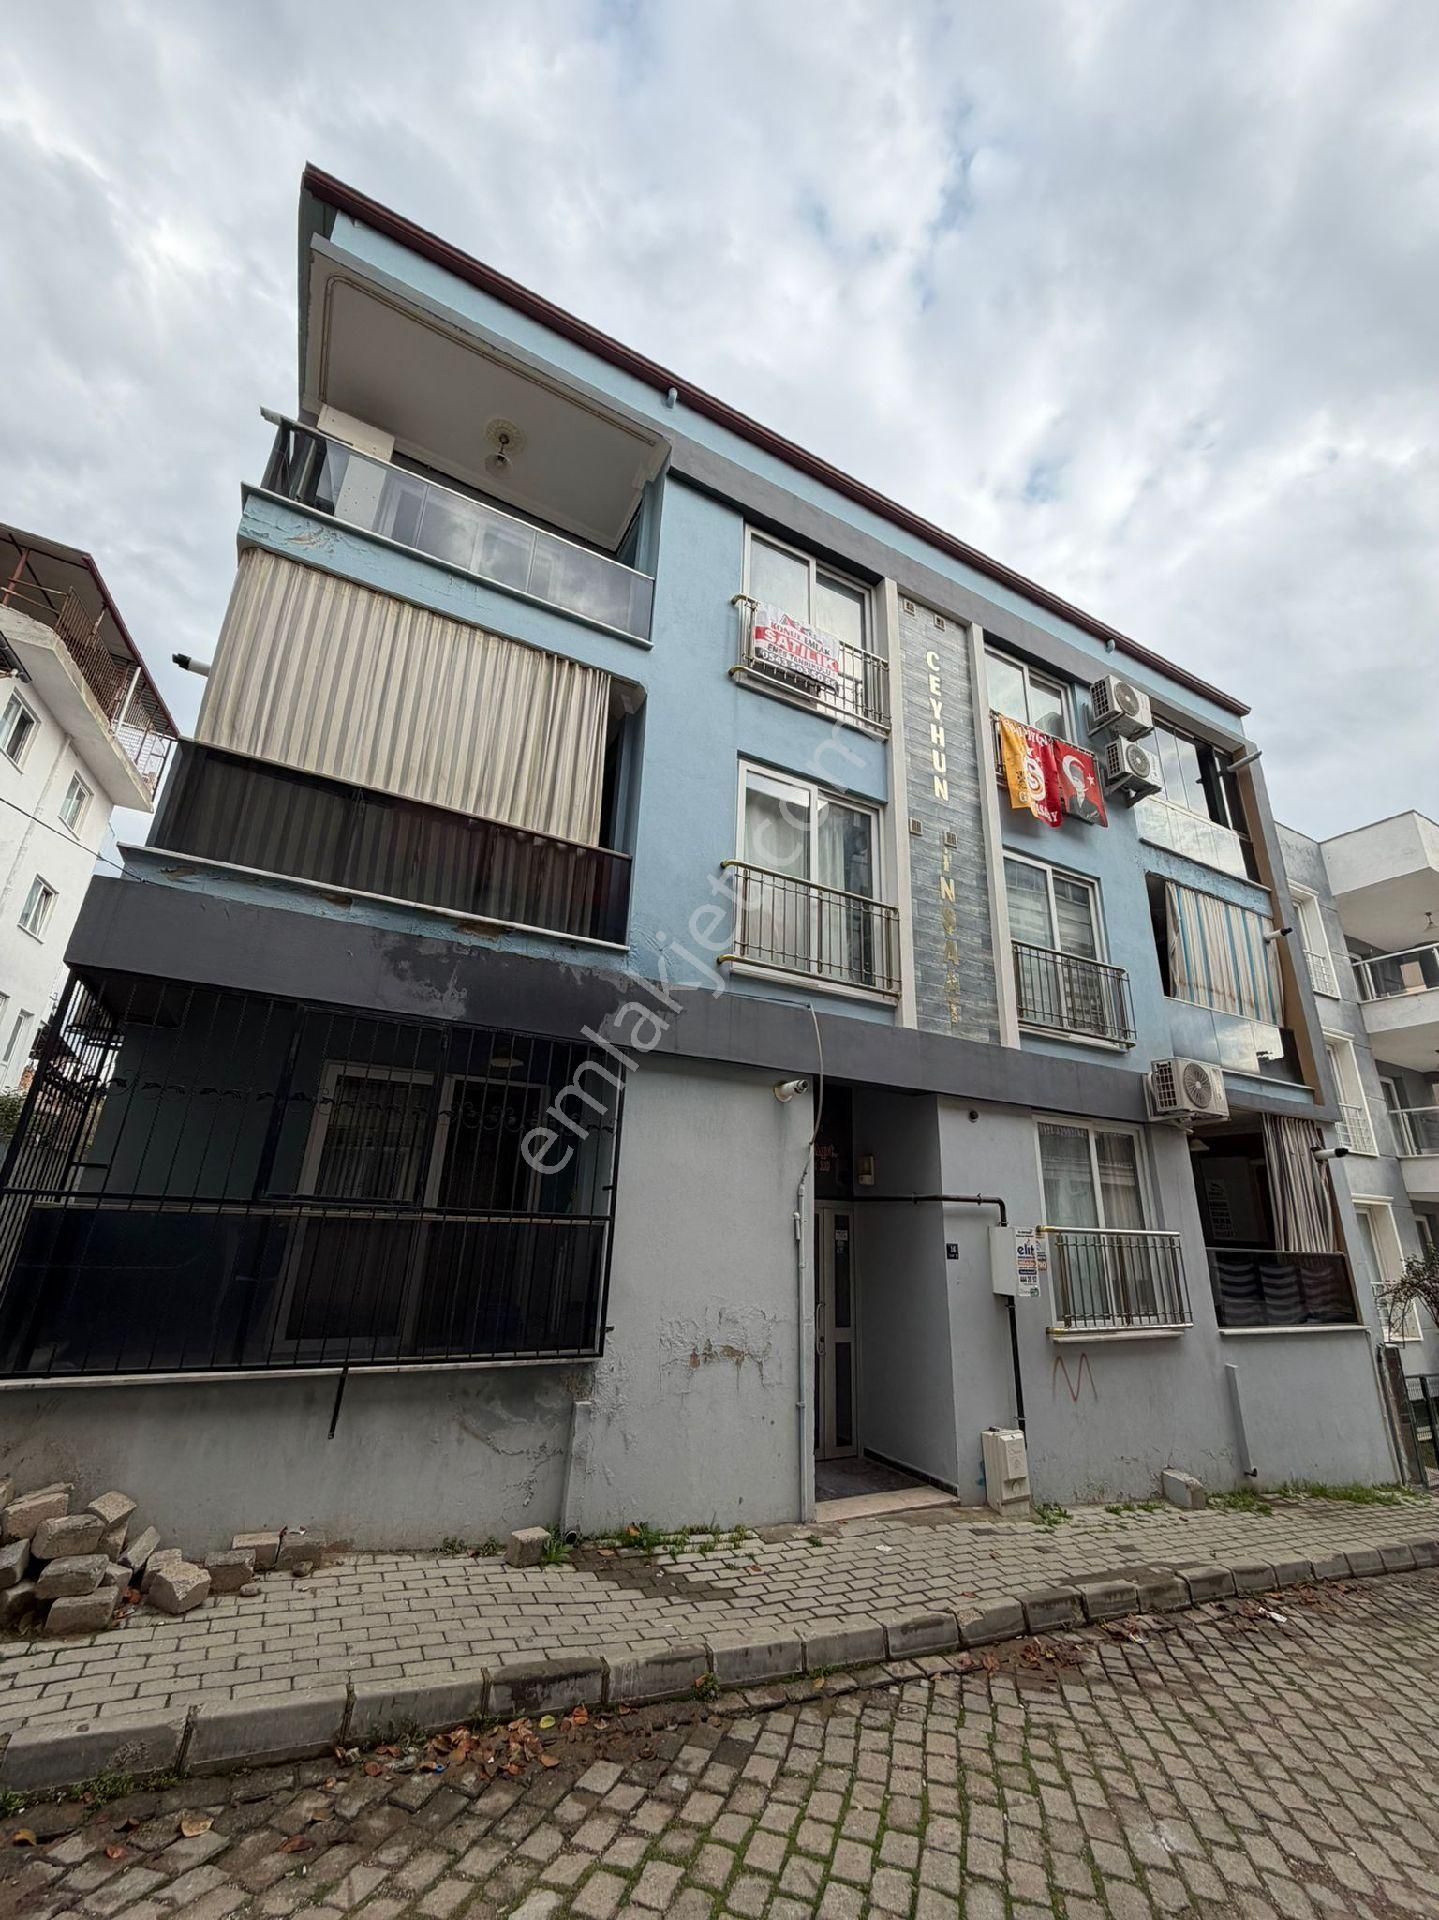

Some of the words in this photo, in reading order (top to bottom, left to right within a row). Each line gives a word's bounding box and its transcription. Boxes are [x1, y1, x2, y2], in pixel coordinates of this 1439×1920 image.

[763, 628, 834, 670] SATILIK
[926, 650, 949, 802] CEYHUN
[1017, 1243, 1034, 1255] elit
